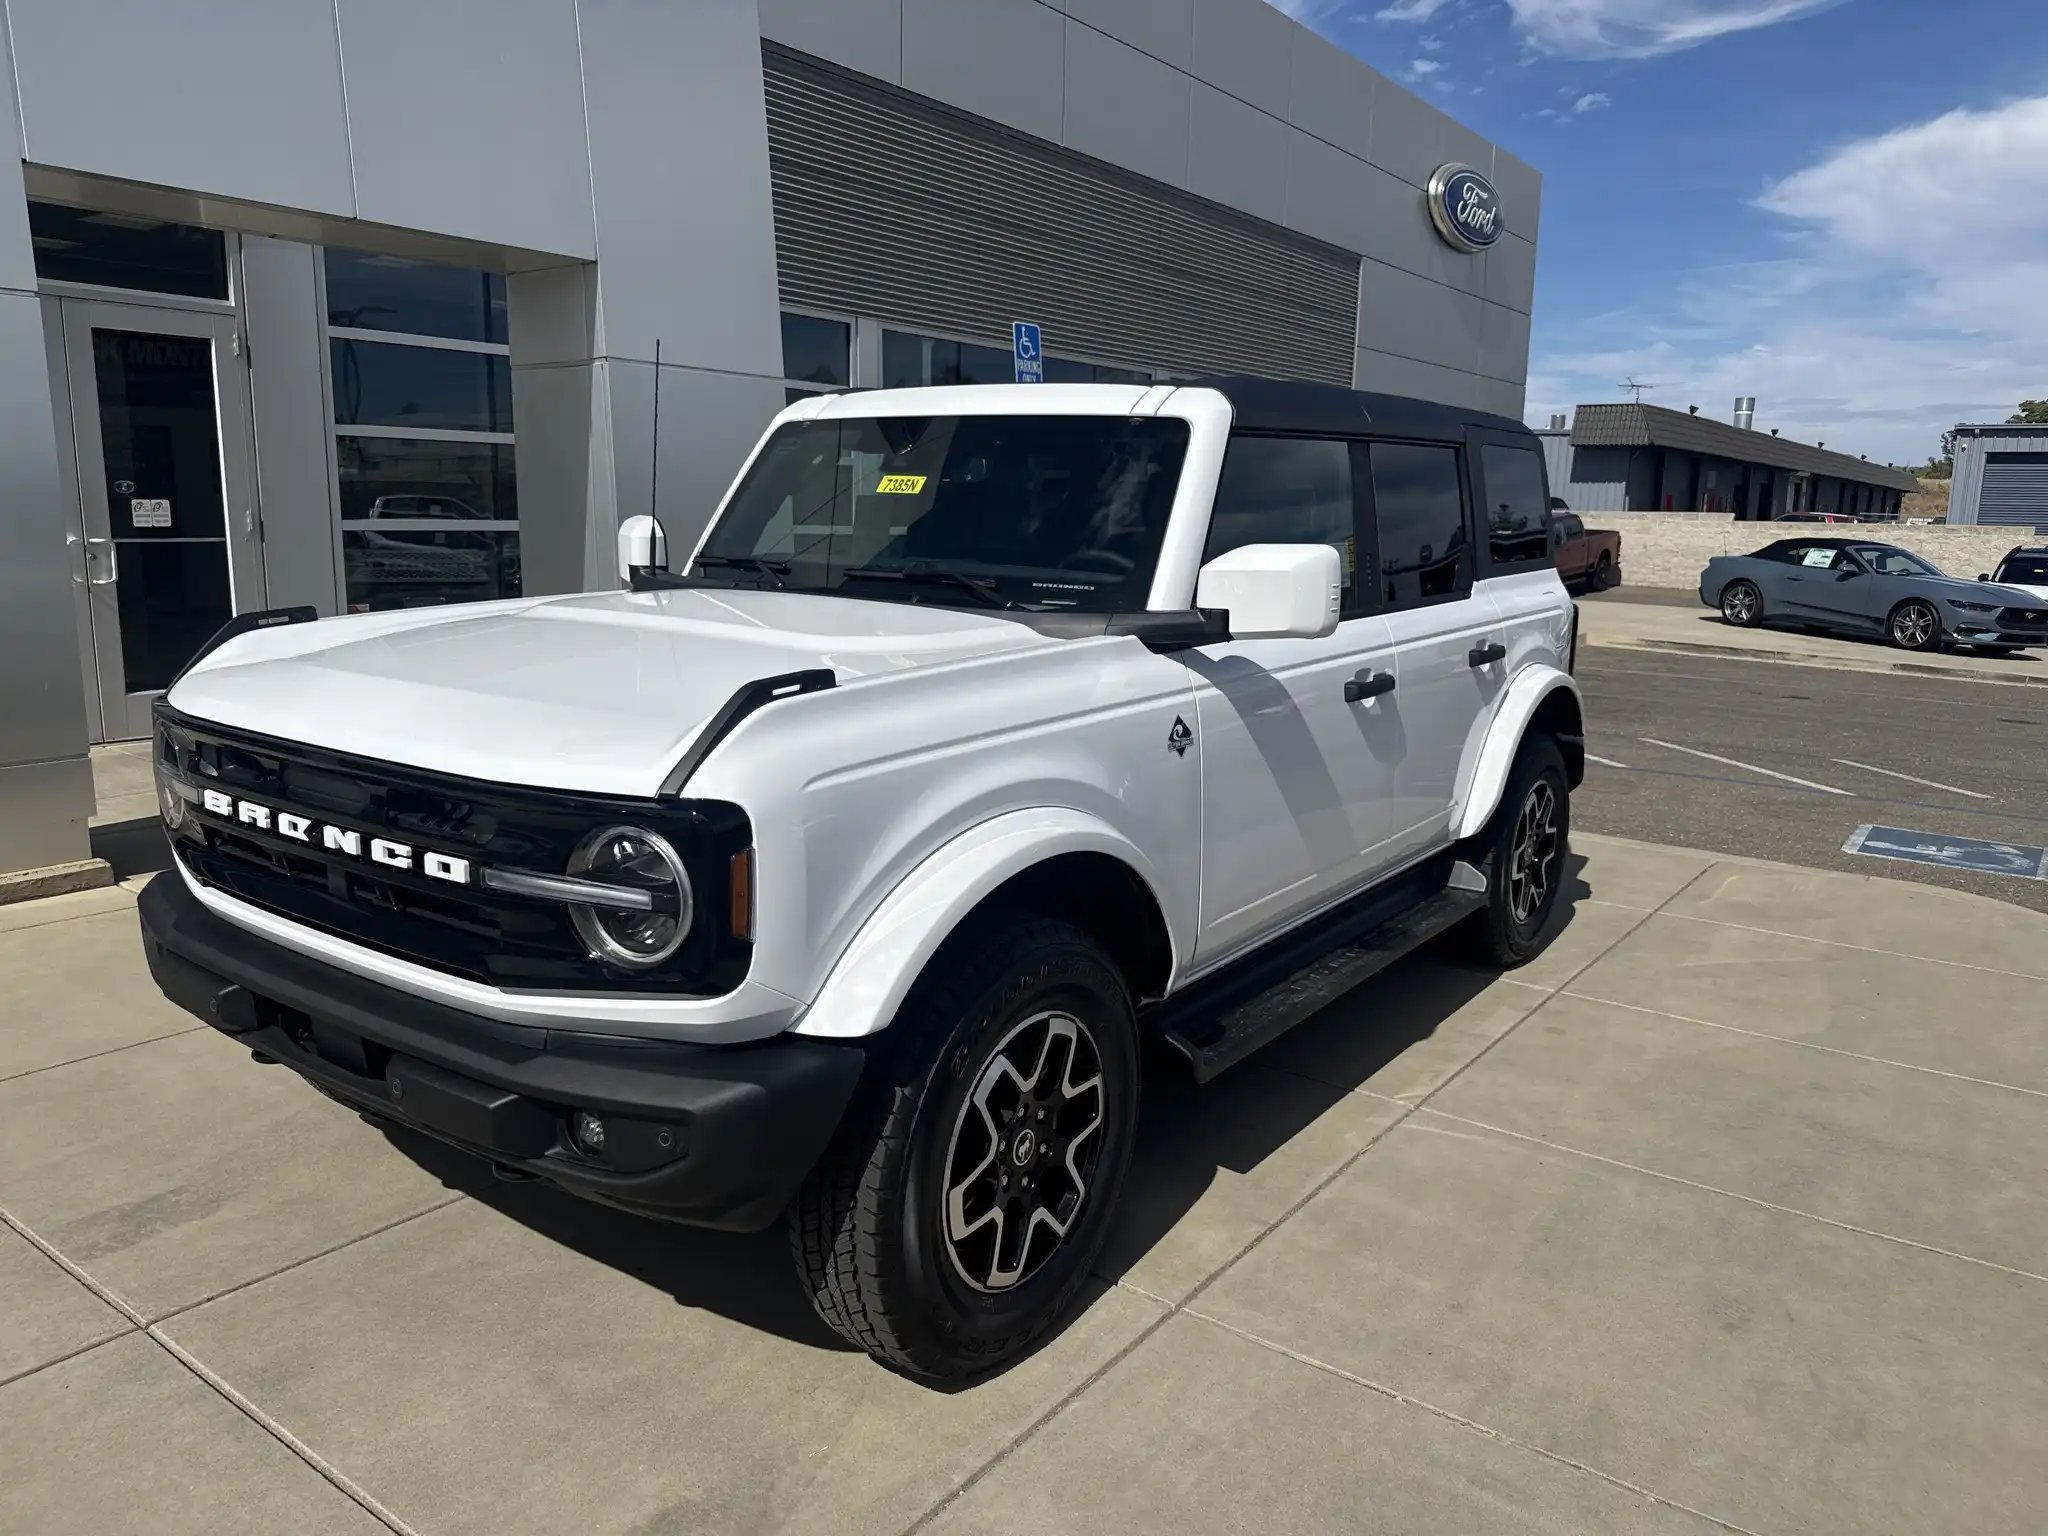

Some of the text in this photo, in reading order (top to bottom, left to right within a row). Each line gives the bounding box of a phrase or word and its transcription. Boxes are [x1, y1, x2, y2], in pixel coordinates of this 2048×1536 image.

[1457, 182, 1496, 235] Ford
[128, 339, 209, 368] MONT
[1017, 358, 1041, 374] PARKING
[883, 478, 919, 492] 7385N
[203, 788, 471, 884] BRONCO
